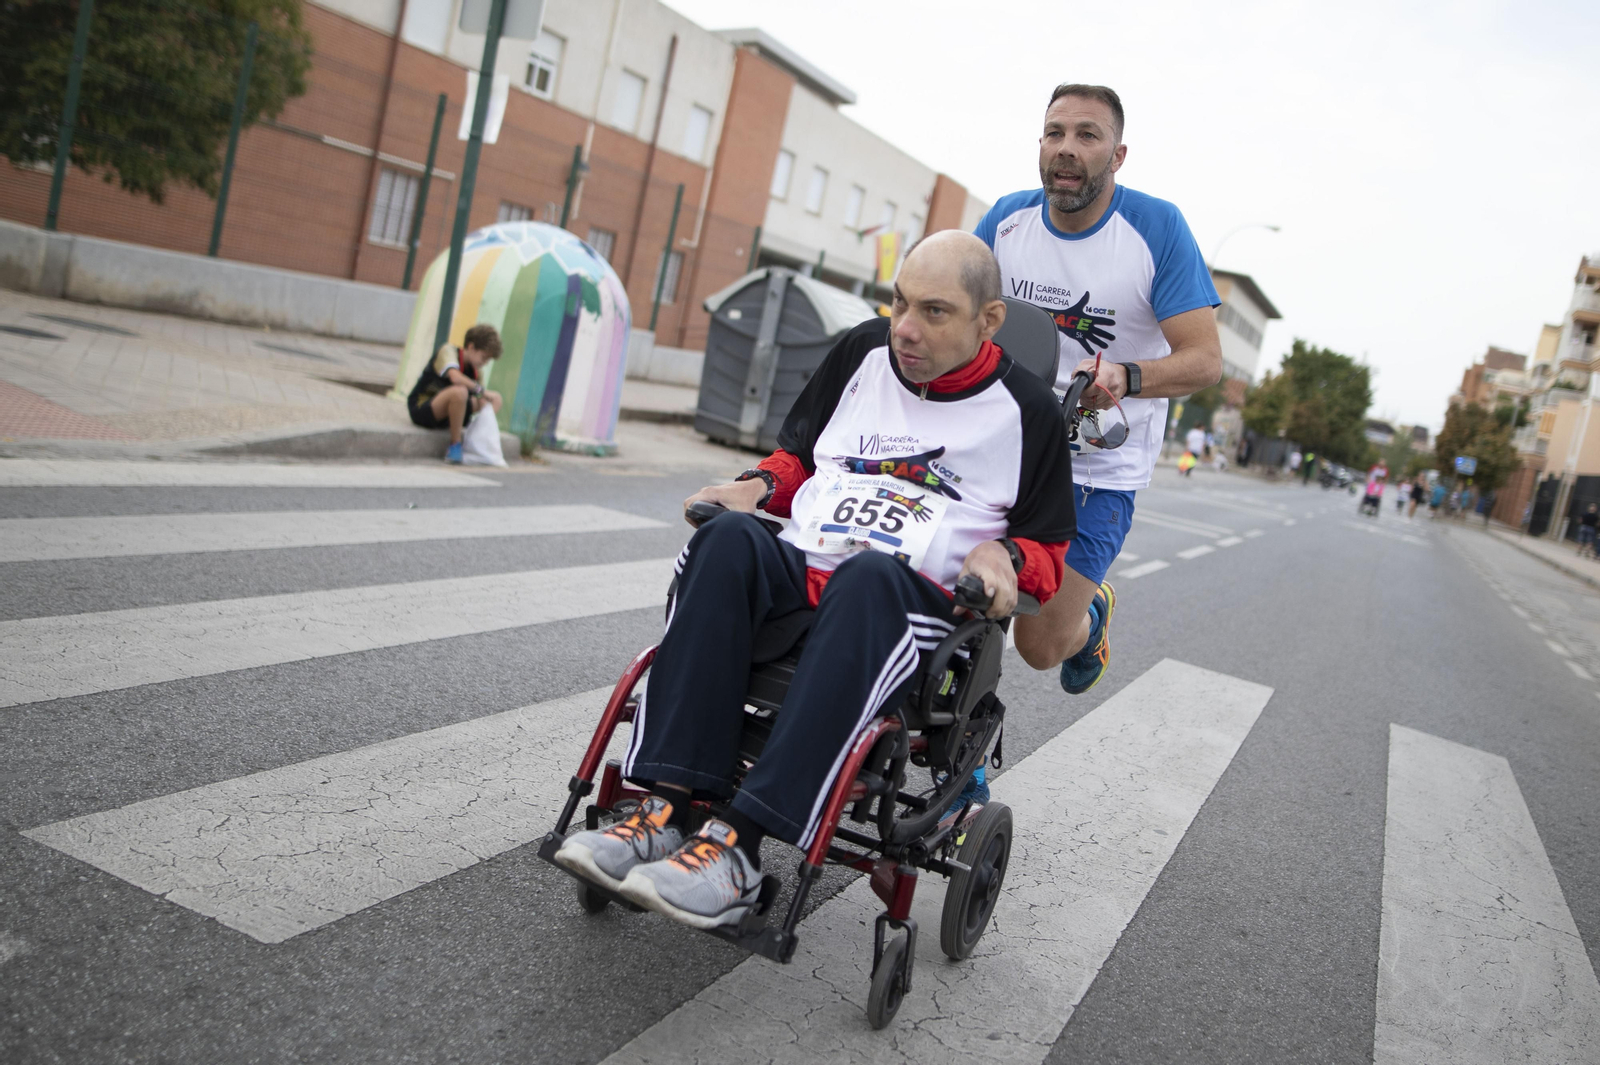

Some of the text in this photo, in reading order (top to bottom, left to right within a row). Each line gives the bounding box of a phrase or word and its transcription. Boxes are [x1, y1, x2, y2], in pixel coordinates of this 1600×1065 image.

[1011, 277, 1034, 300] VII
[1036, 284, 1072, 298] CARRERA
[1034, 294, 1070, 307] MARCHA
[1093, 307, 1107, 315] OCT
[1048, 311, 1093, 331] ACE
[860, 433, 880, 455] VII
[880, 435, 919, 444] CARRERA
[880, 444, 915, 454] MARCHA
[931, 461, 940, 470] 16
[939, 466, 955, 479] OCT
[880, 481, 905, 493] MARCHA
[833, 497, 909, 533] 655
